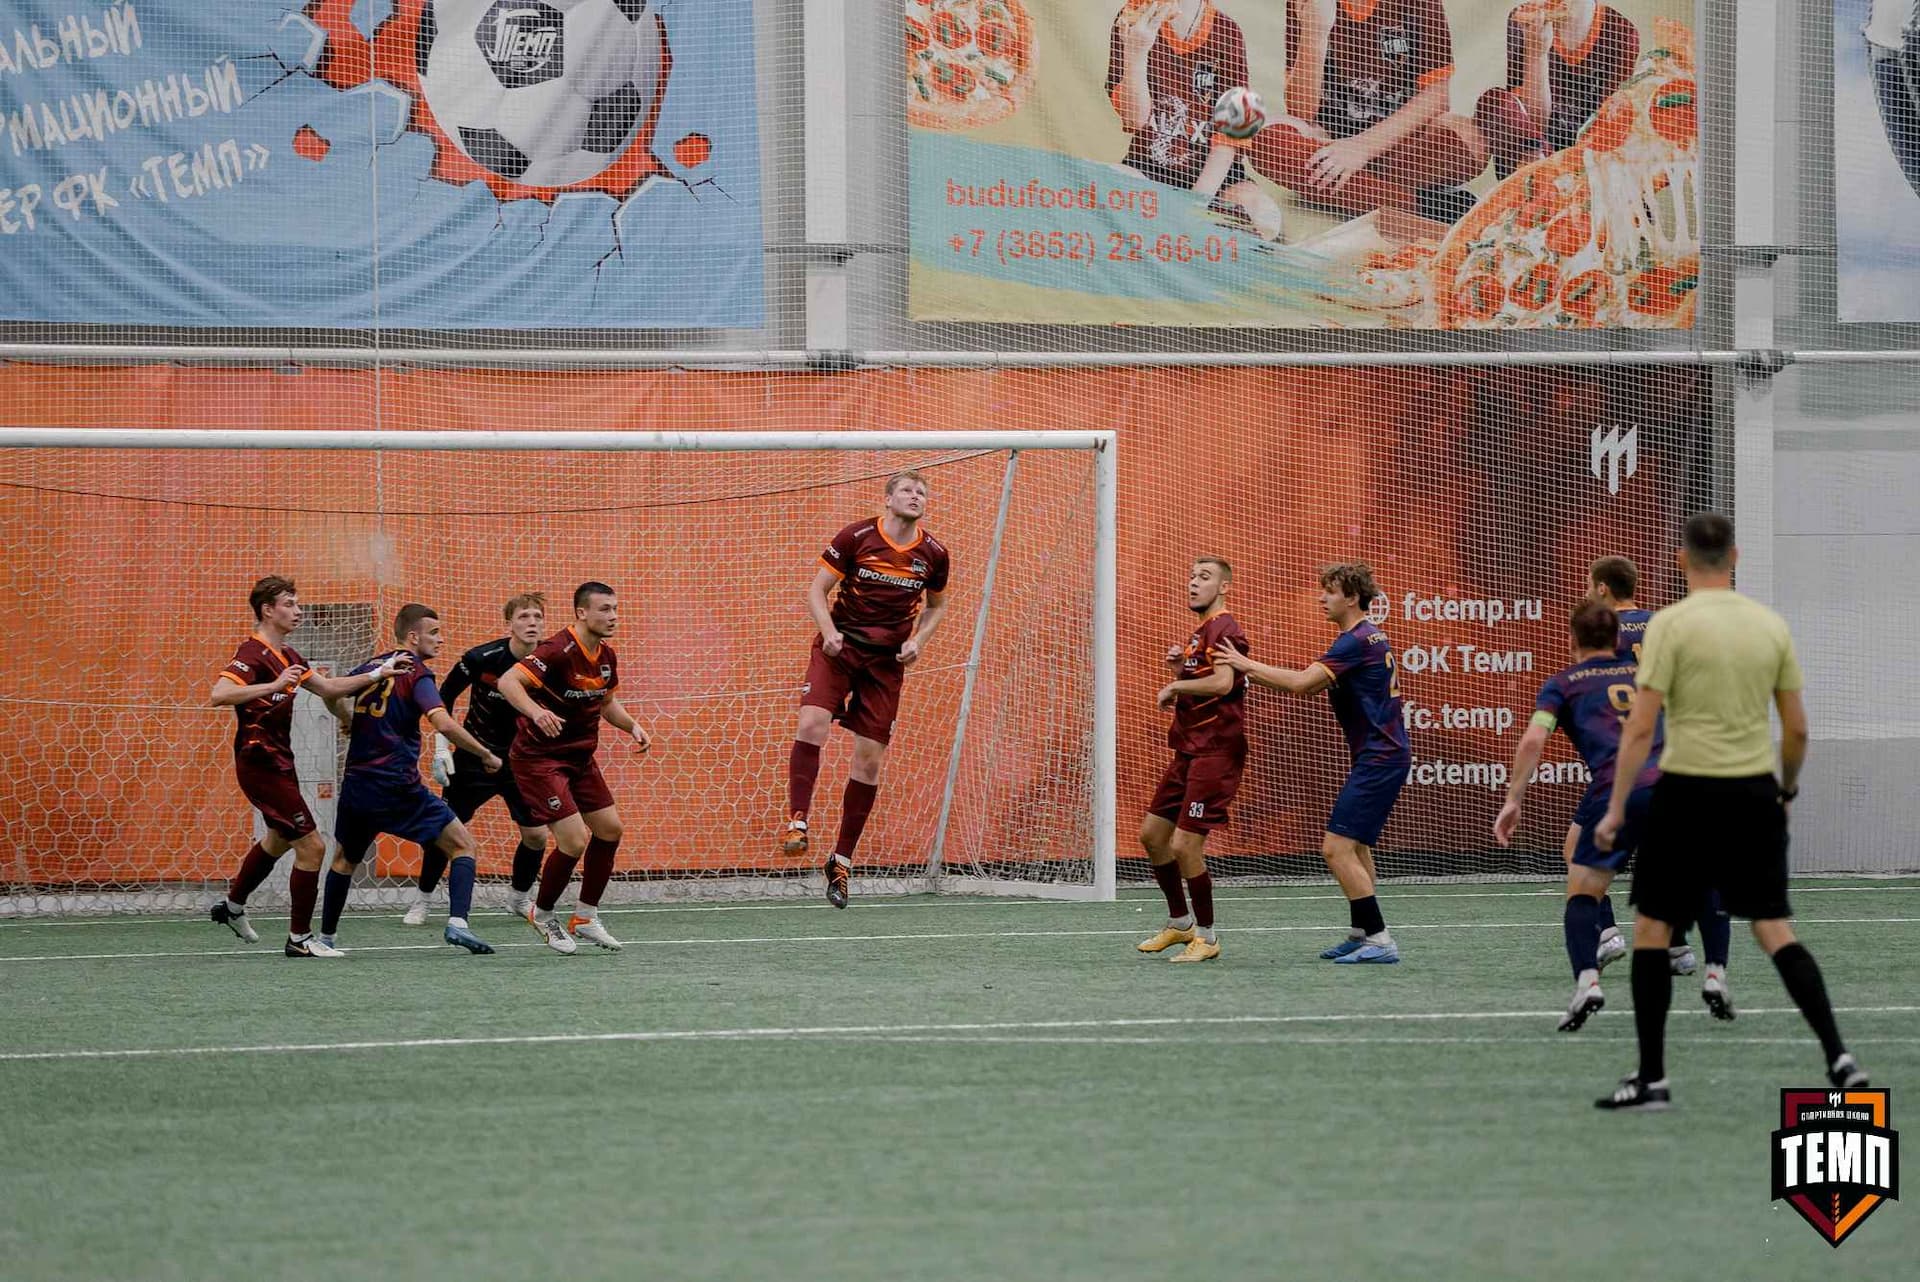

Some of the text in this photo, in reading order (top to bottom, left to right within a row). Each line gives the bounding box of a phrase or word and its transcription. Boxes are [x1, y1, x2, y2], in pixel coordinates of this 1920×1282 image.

[0, 54, 243, 157] МАЦИОННЫЙ
[53, 167, 120, 221] ФК
[129, 139, 270, 203] «ТЕМП»
[945, 178, 1160, 219] budufood.org
[948, 229, 1240, 268] +7 (3852) 22-66-01
[1403, 592, 1543, 628] fctemp.ru
[1402, 645, 1533, 674] ФК Темп
[354, 676, 396, 718] 23
[1401, 700, 1513, 736] fc.temp
[1189, 802, 1205, 819] 33
